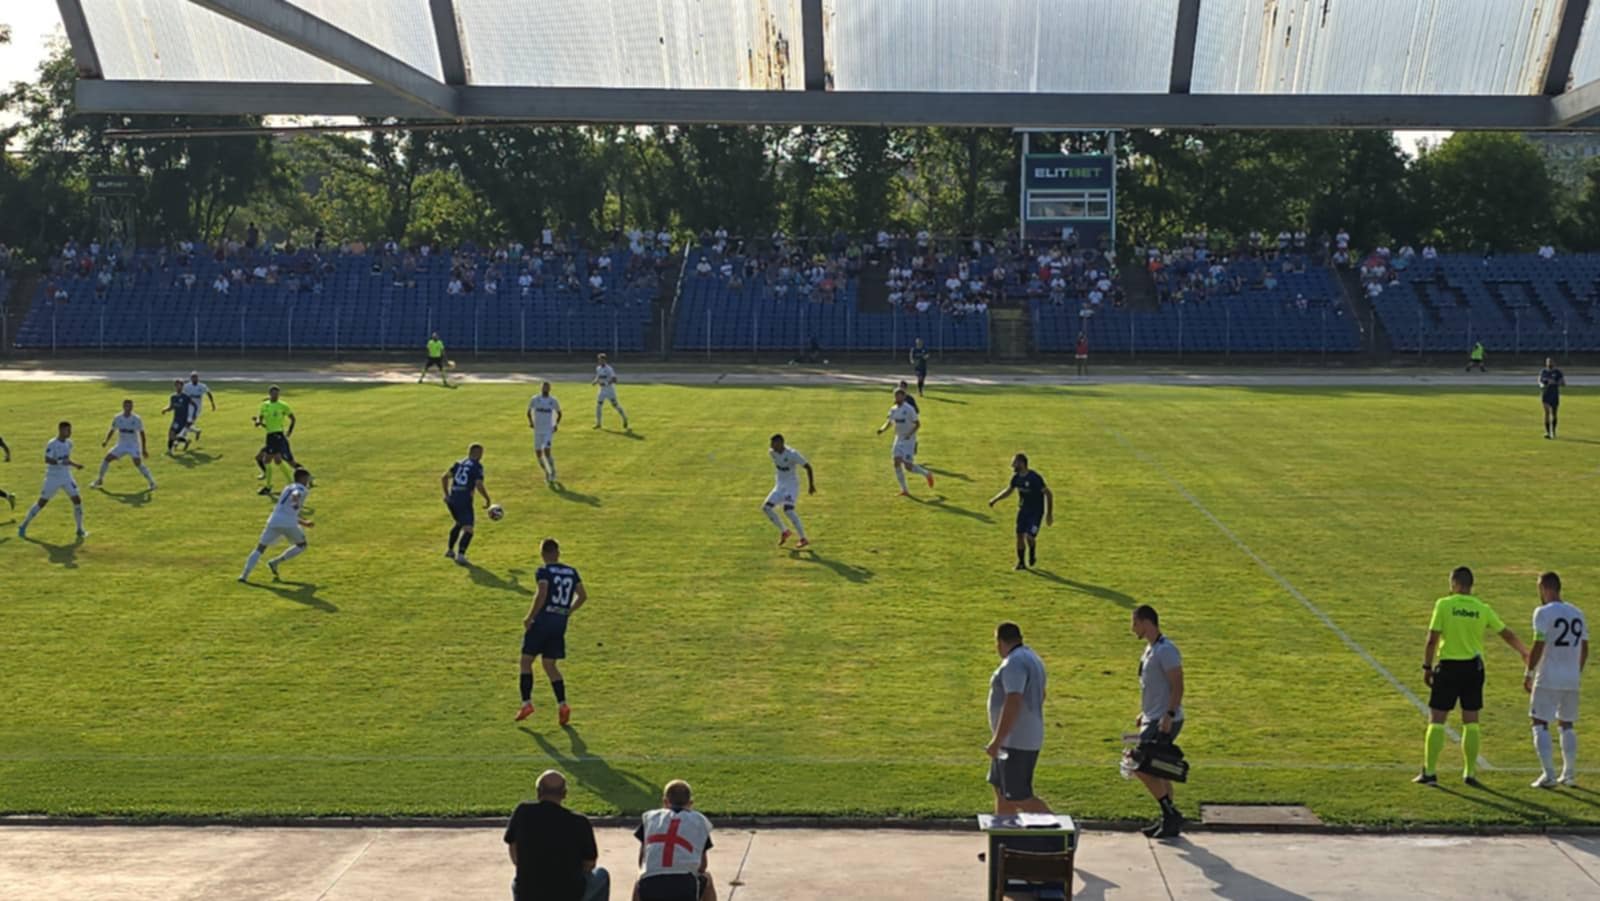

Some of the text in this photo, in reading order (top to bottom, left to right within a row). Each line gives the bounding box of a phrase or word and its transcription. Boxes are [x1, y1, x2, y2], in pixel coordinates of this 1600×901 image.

[552, 576, 573, 605] 33
[1452, 607, 1480, 619] inbet
[1553, 617, 1583, 647] 29
